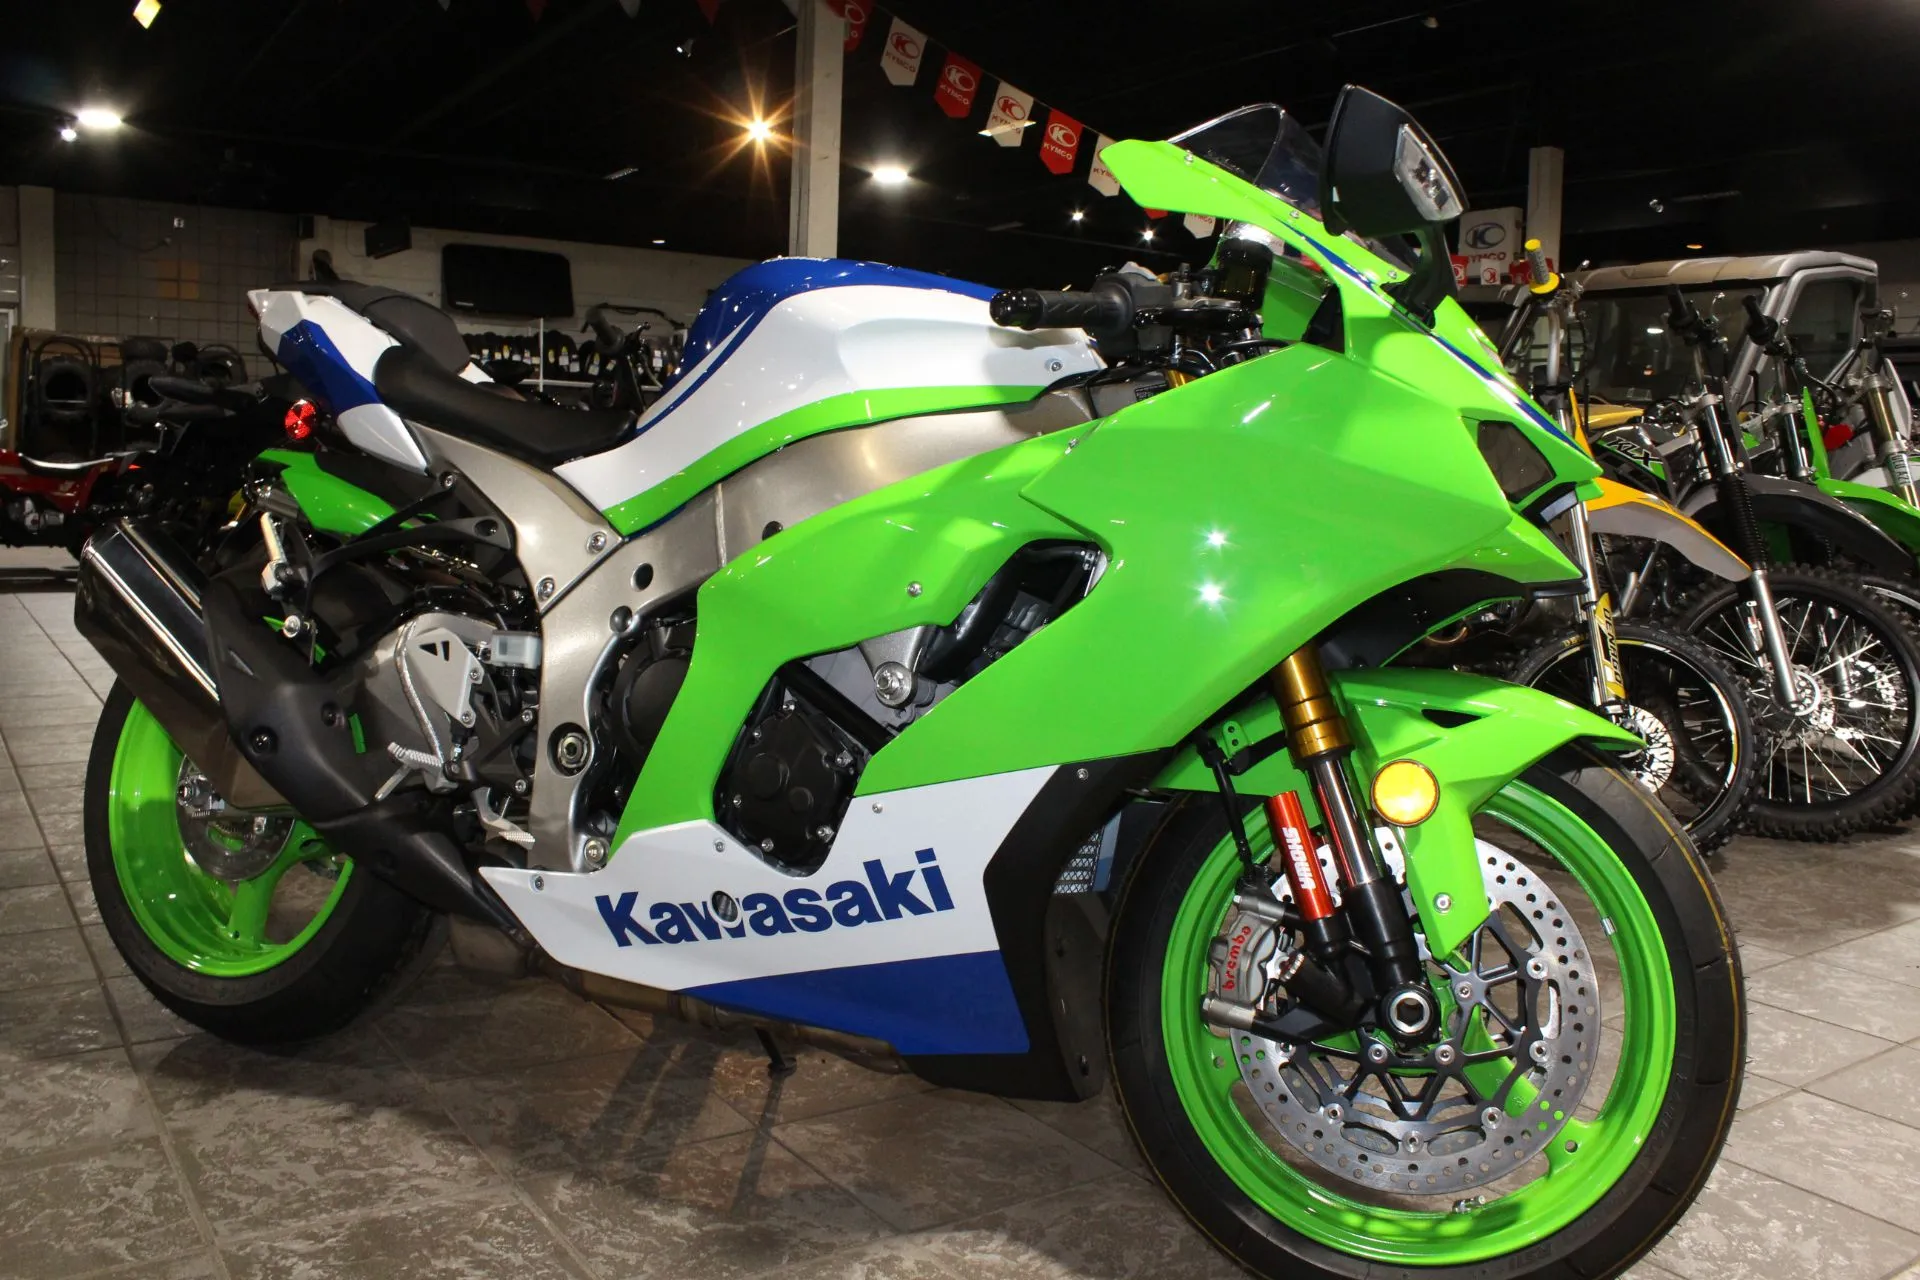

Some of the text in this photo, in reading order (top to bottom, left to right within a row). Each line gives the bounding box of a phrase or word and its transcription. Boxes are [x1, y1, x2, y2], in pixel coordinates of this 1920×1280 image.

[885, 50, 916, 73] KYMCO
[1043, 142, 1073, 160] KYMCO
[1468, 252, 1506, 263] YMCO
[1603, 436, 1663, 471] KLX
[1282, 827, 1317, 890] SHOWA
[594, 847, 955, 948] Kawasaki
[1222, 925, 1252, 991] brembo
